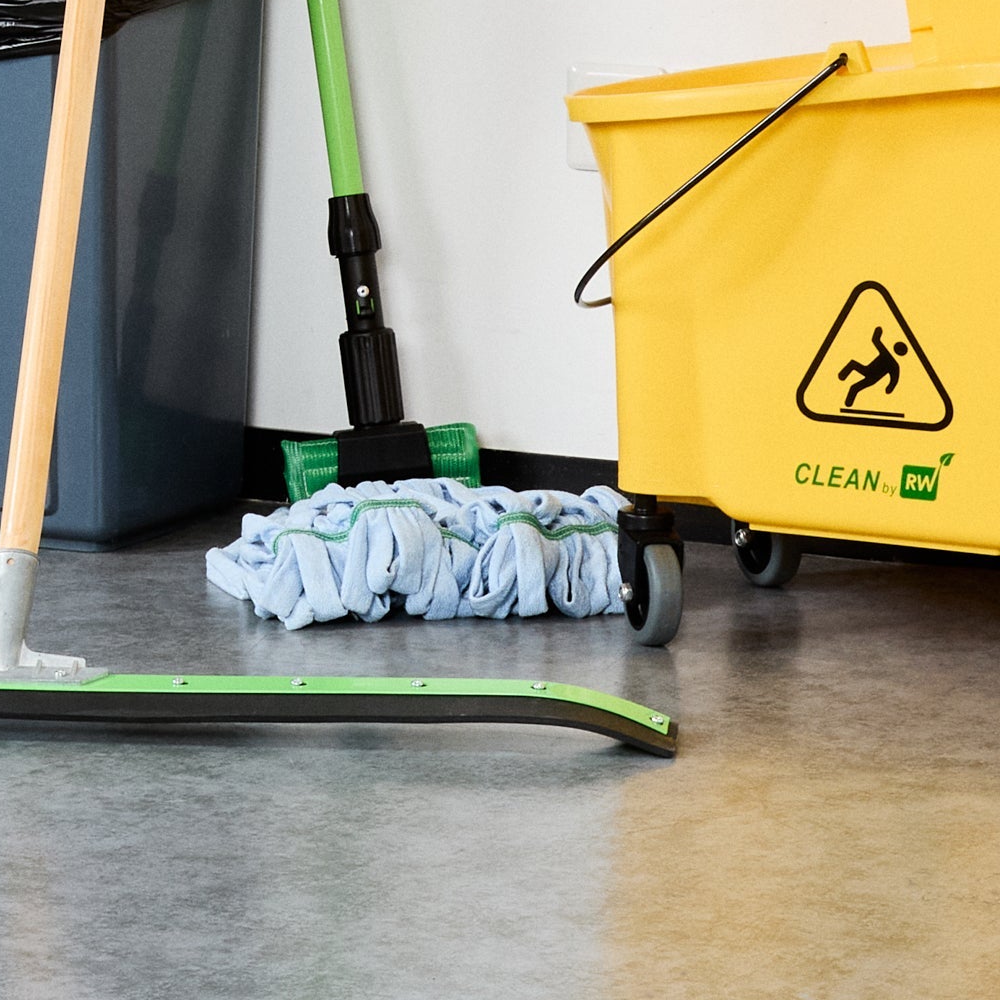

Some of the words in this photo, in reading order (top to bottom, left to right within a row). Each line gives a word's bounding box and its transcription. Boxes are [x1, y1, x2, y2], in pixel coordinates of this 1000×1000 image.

[794, 463, 880, 492] CLEAN
[881, 482, 898, 497] by
[905, 471, 939, 493] RW
